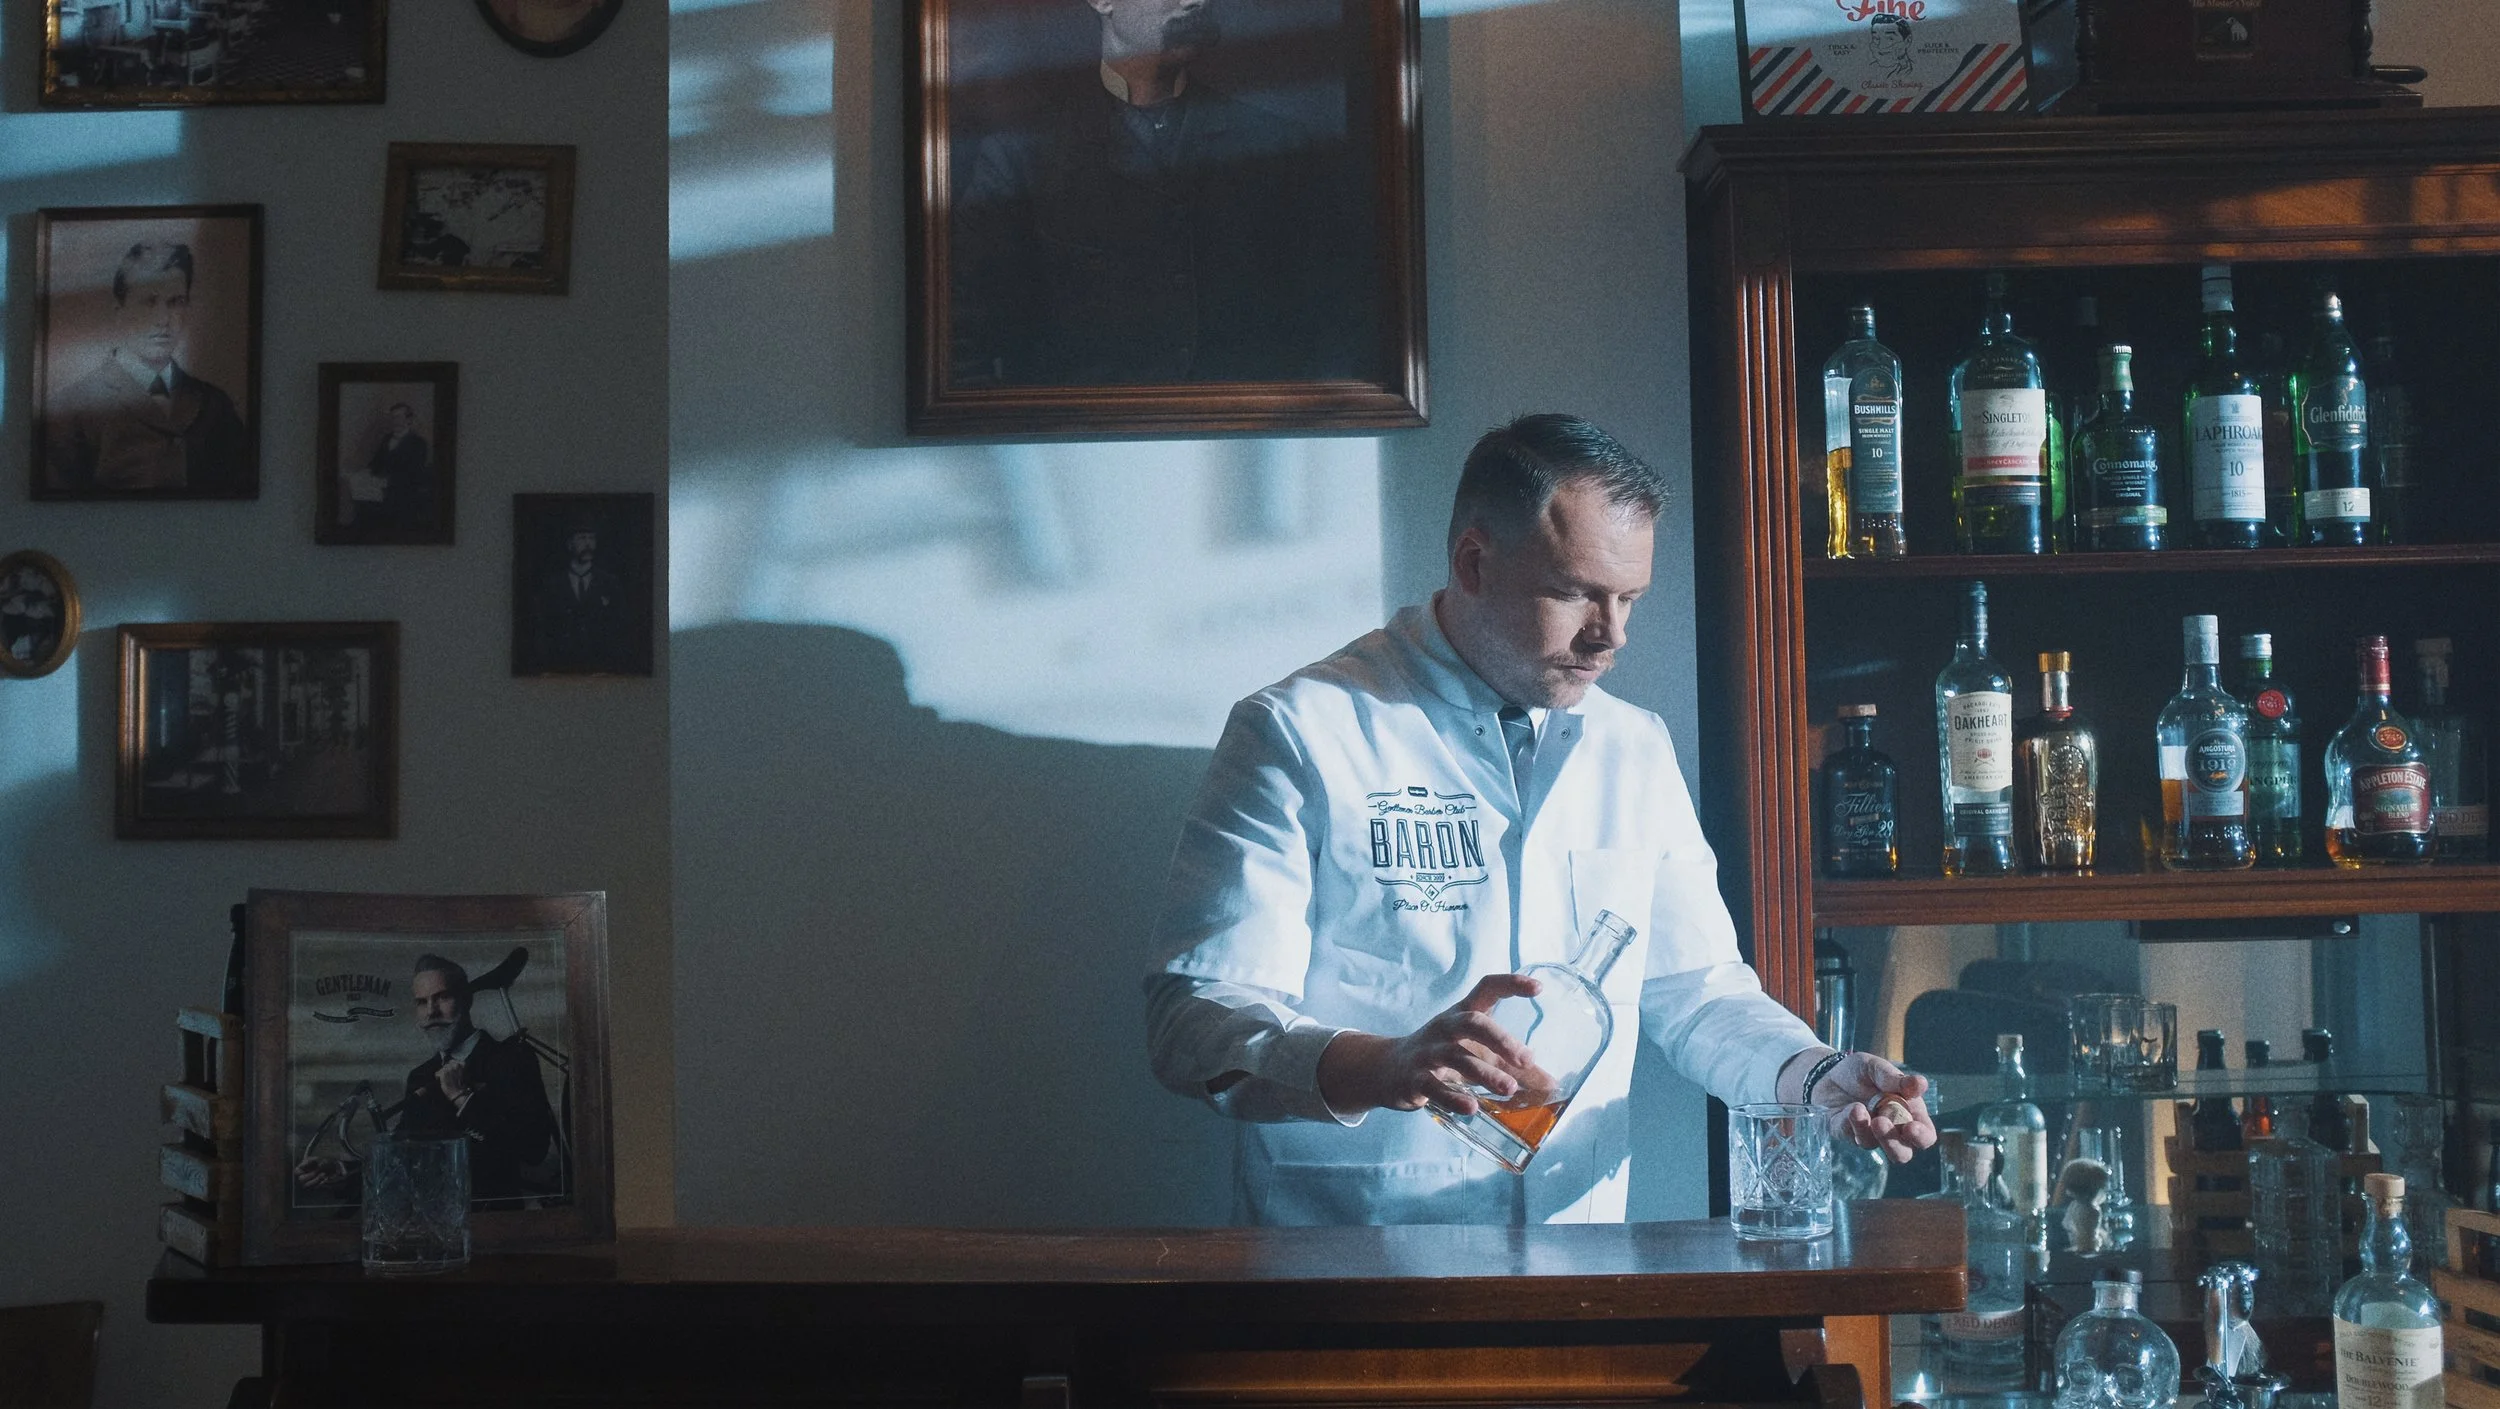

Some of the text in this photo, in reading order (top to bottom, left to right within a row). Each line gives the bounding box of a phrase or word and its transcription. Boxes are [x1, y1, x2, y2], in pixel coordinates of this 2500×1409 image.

[1854, 404, 1897, 414] BUSHMILLS
[1871, 447, 1883, 459] 10
[2229, 460, 2244, 476] 10
[2343, 501, 2355, 513] 12
[1954, 713, 2008, 731] OAKHEART
[2198, 744, 2236, 754] ANGOSTURA
[2198, 758, 2237, 771] 1919
[2359, 771, 2427, 791] APPLETON ESTATE
[1444, 803, 1466, 816] Club
[1370, 818, 1485, 869] BARON
[316, 974, 392, 998] GENTLEMAN
[2355, 1350, 2418, 1367] BALVENIE
[2368, 1395, 2382, 1408] 12
